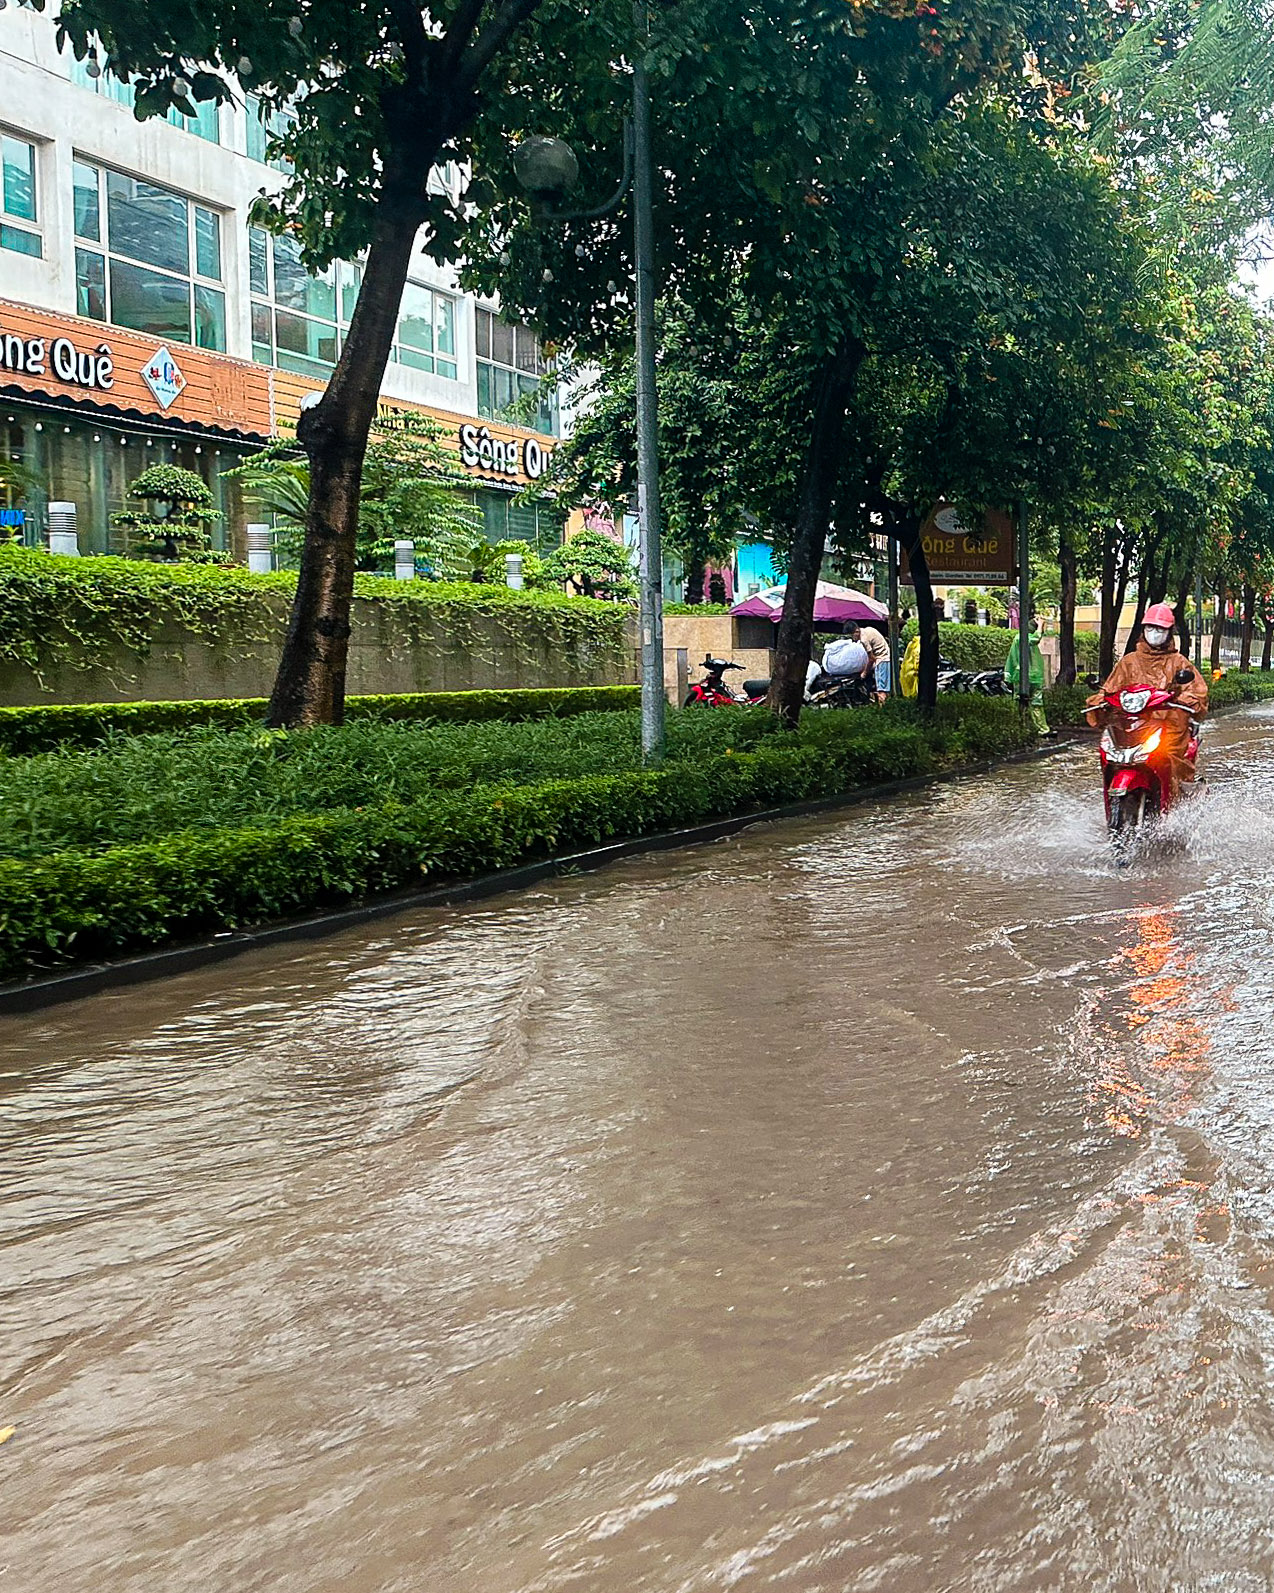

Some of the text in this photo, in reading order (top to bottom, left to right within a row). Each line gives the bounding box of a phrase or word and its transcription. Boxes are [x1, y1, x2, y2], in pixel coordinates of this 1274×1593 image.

[0, 334, 114, 389] ng Quê
[462, 424, 519, 475] Sông
[526, 438, 562, 478] Qu
